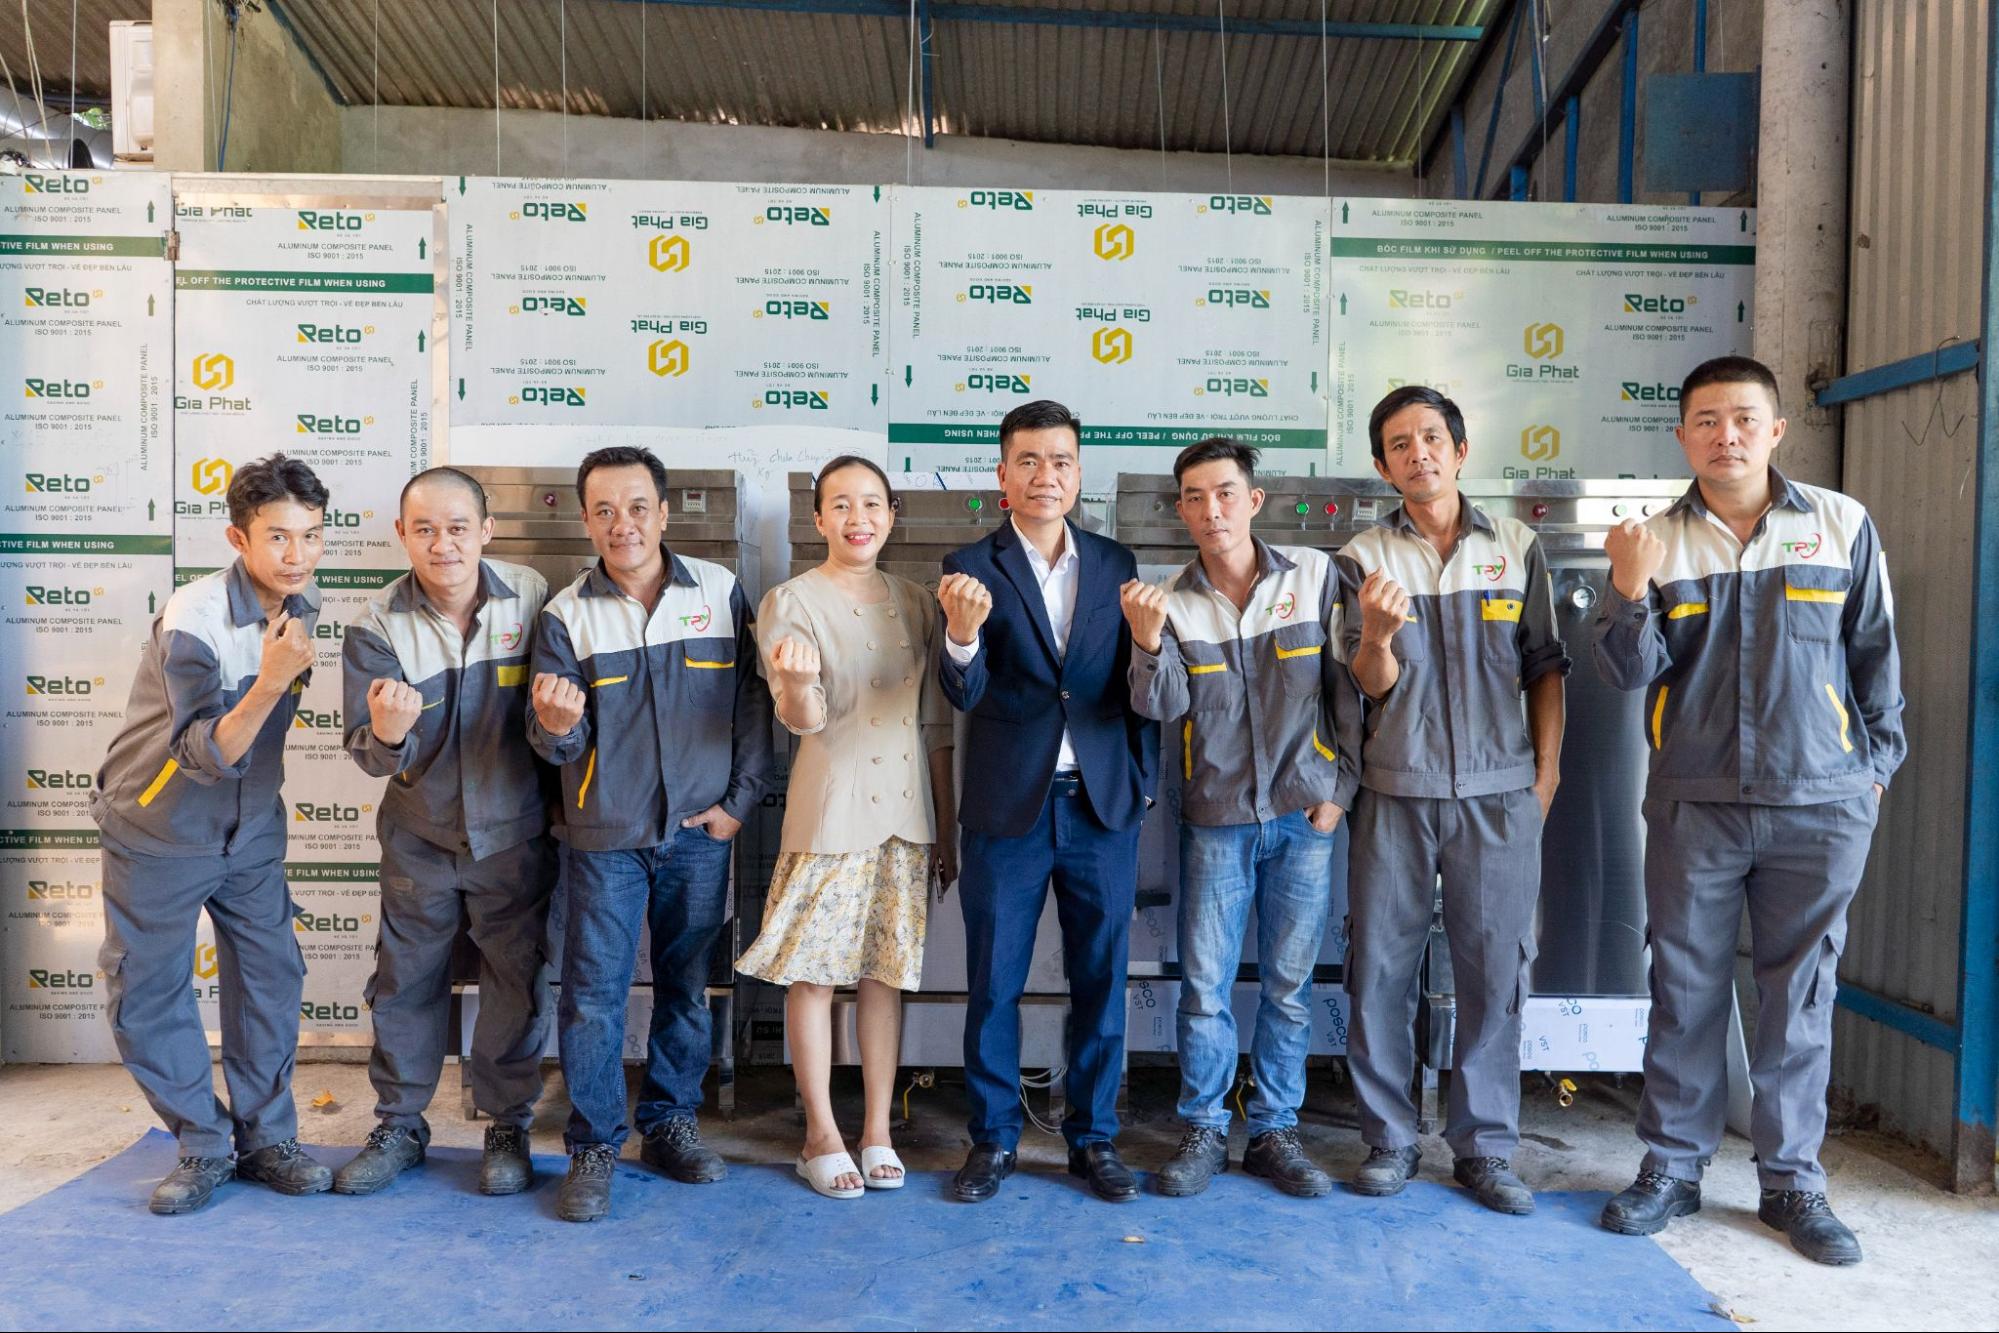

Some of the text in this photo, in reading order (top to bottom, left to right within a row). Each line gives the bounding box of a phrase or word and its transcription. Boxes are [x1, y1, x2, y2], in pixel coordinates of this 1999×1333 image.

[24, 174, 90, 194] Reto
[970, 192, 1034, 210] Reto
[1210, 196, 1272, 216] Reto
[522, 202, 587, 222] Reto
[766, 206, 830, 226] Reto
[1078, 204, 1152, 218] Gia Phat
[1372, 210, 1483, 220] ALUMINUM COMPOSITE PANEL
[298, 210, 362, 230] Reto
[632, 216, 708, 230] Gia Phat
[26, 241, 48, 250] FILM
[51, 242, 80, 251] WHEN
[83, 242, 114, 252] USING
[278, 242, 319, 250] ALUMINUM
[321, 243, 366, 251] COMPOSITE
[1400, 245, 1422, 254] FILM
[1424, 246, 1441, 254] KHI
[1498, 248, 1520, 256] PEEL
[1524, 248, 1542, 256] OFF
[1545, 248, 1563, 257] THE
[1566, 249, 1624, 258] PROTECTIVE
[1626, 250, 1648, 258] FILM
[1650, 250, 1678, 259] WHEN
[1680, 250, 1709, 260] USING
[308, 252, 364, 260] ISO 9001 2015
[564, 274, 606, 282] ALUMINUM
[764, 268, 820, 276] ISO 9001 2015
[190, 276, 386, 288] OFF THE PROTECTIVE FILM WHEN USING
[25, 287, 90, 307] Reto
[969, 285, 1032, 304] Reto
[1208, 290, 1270, 309] Reto
[1389, 289, 1450, 308] Reto
[766, 300, 830, 320] Reto
[1624, 294, 1685, 313] Reto
[1076, 307, 1150, 322] Gia Phat
[4, 320, 122, 328] ALUMINUM COMPOSITE PANEL
[631, 320, 708, 334] Gia Phat
[1604, 324, 1644, 332] ALUMINUM
[34, 328, 92, 336] ISO 9001 2015
[297, 323, 362, 343] Reto
[1506, 365, 1580, 378] Gia Phat
[25, 378, 90, 398] Reto
[968, 374, 1031, 394] Reto
[1207, 378, 1268, 398] Reto
[1621, 382, 1682, 401] Reto
[174, 396, 252, 411] Gia Phat
[522, 387, 586, 407] Reto
[766, 390, 829, 410] Reto
[296, 414, 361, 434] Reto
[944, 429, 974, 438] USING
[1094, 430, 1114, 439] THE
[1116, 430, 1134, 439] OFF
[1140, 431, 1160, 440] PEEL
[1236, 432, 1258, 442] FILM
[1503, 466, 1576, 480] Gia Phat
[26, 473, 90, 493] Reto
[174, 501, 202, 514] Gia
[0, 540, 114, 550] TIVE FILM WHEN USING
[322, 576, 384, 584] WHEN USING
[26, 586, 90, 605] Reto
[36, 626, 93, 634] ISO 9001 2015
[26, 676, 91, 695] Reto
[27, 770, 92, 788] Reto
[295, 802, 359, 822] Reto
[29, 836, 51, 844] FILM
[54, 836, 83, 844] WHEN
[318, 834, 363, 842] COMPOSITE
[296, 869, 319, 878] FILM
[322, 869, 350, 878] WHEN
[28, 880, 93, 900] Reto
[294, 912, 358, 932] Reto
[30, 969, 94, 989] Reto
[299, 1001, 358, 1020] Reto
